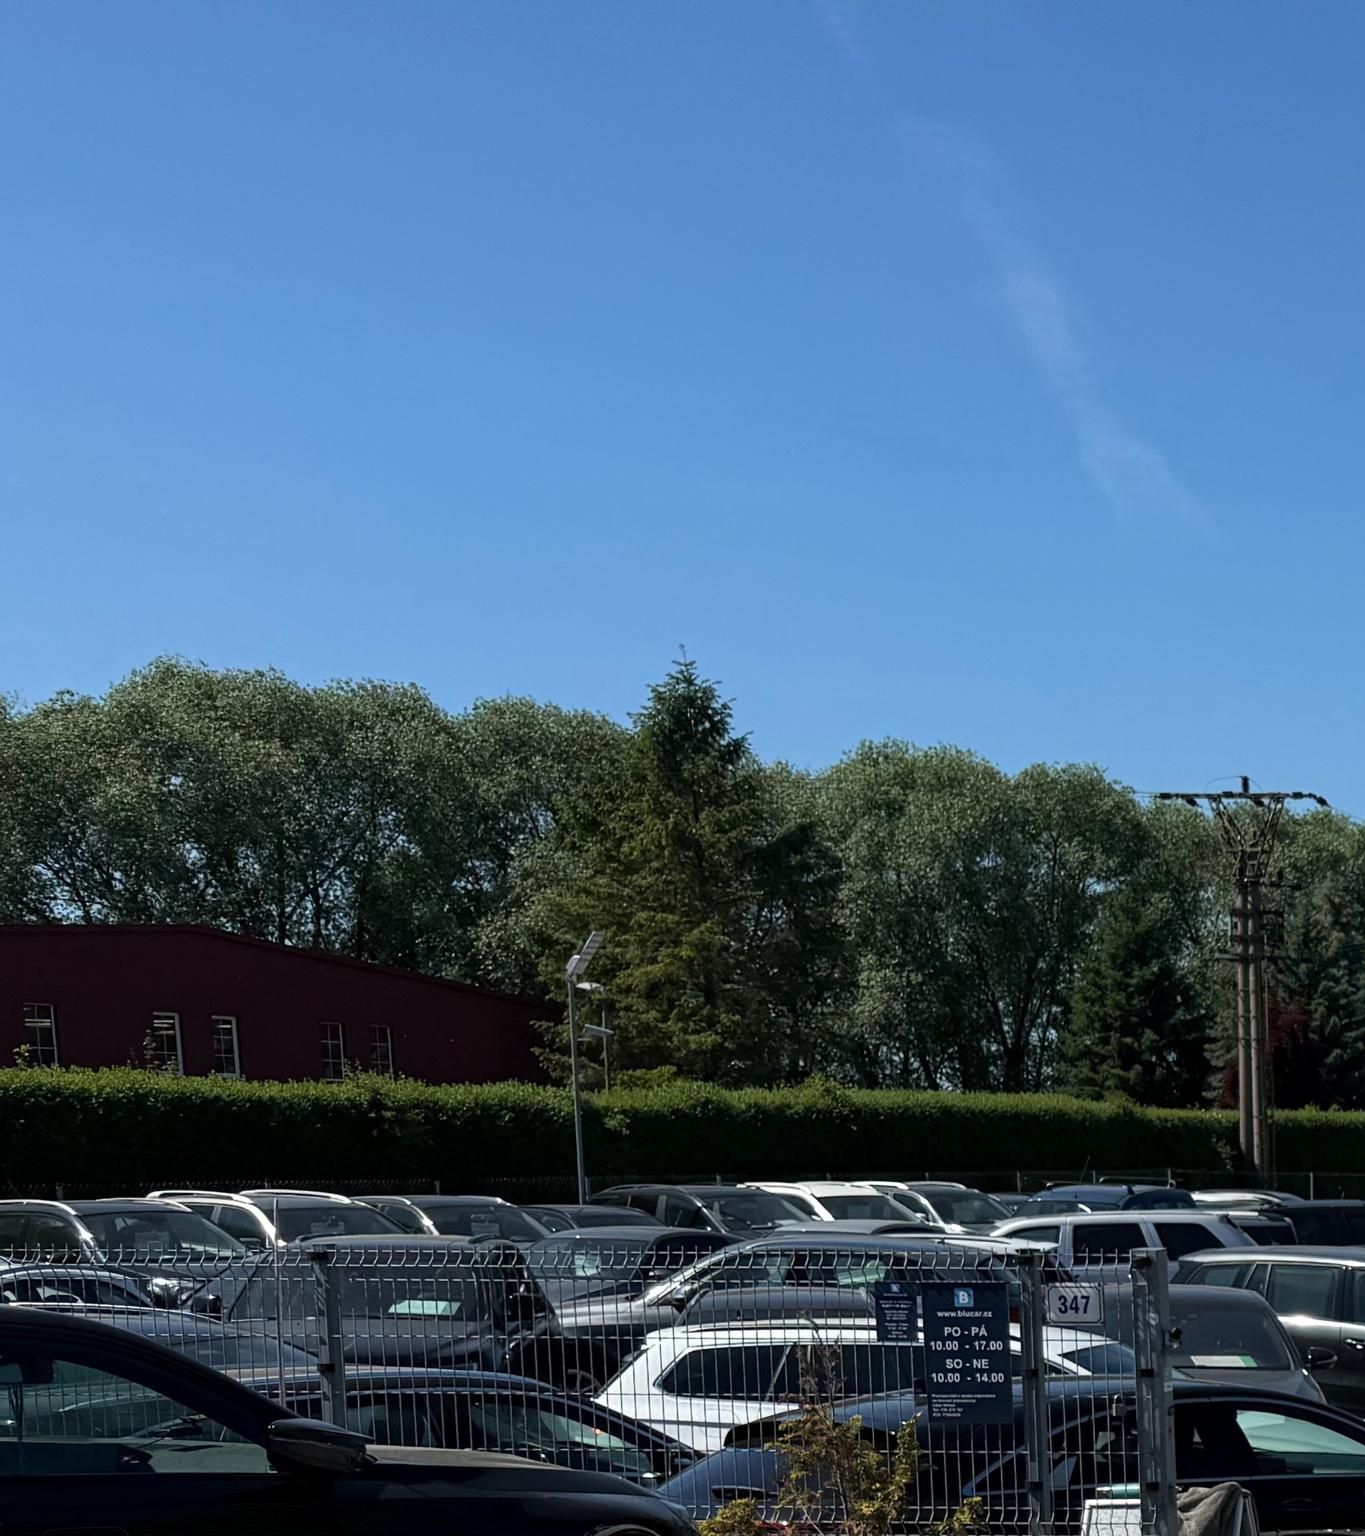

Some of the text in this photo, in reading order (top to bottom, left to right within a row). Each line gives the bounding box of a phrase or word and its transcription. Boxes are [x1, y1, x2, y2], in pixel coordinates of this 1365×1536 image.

[959, 1290, 969, 1304] B
[1058, 1294, 1090, 1314] 347
[936, 1310, 993, 1318] www.blucar.cz
[944, 1326, 961, 1337] PO
[971, 1324, 988, 1337] PÁ
[930, 1340, 959, 1351] 10.00
[974, 1340, 1004, 1351] 17.00
[945, 1358, 963, 1369] SO
[972, 1358, 990, 1369] NE
[931, 1372, 961, 1383] 10.00
[975, 1372, 1005, 1383] 14.00
